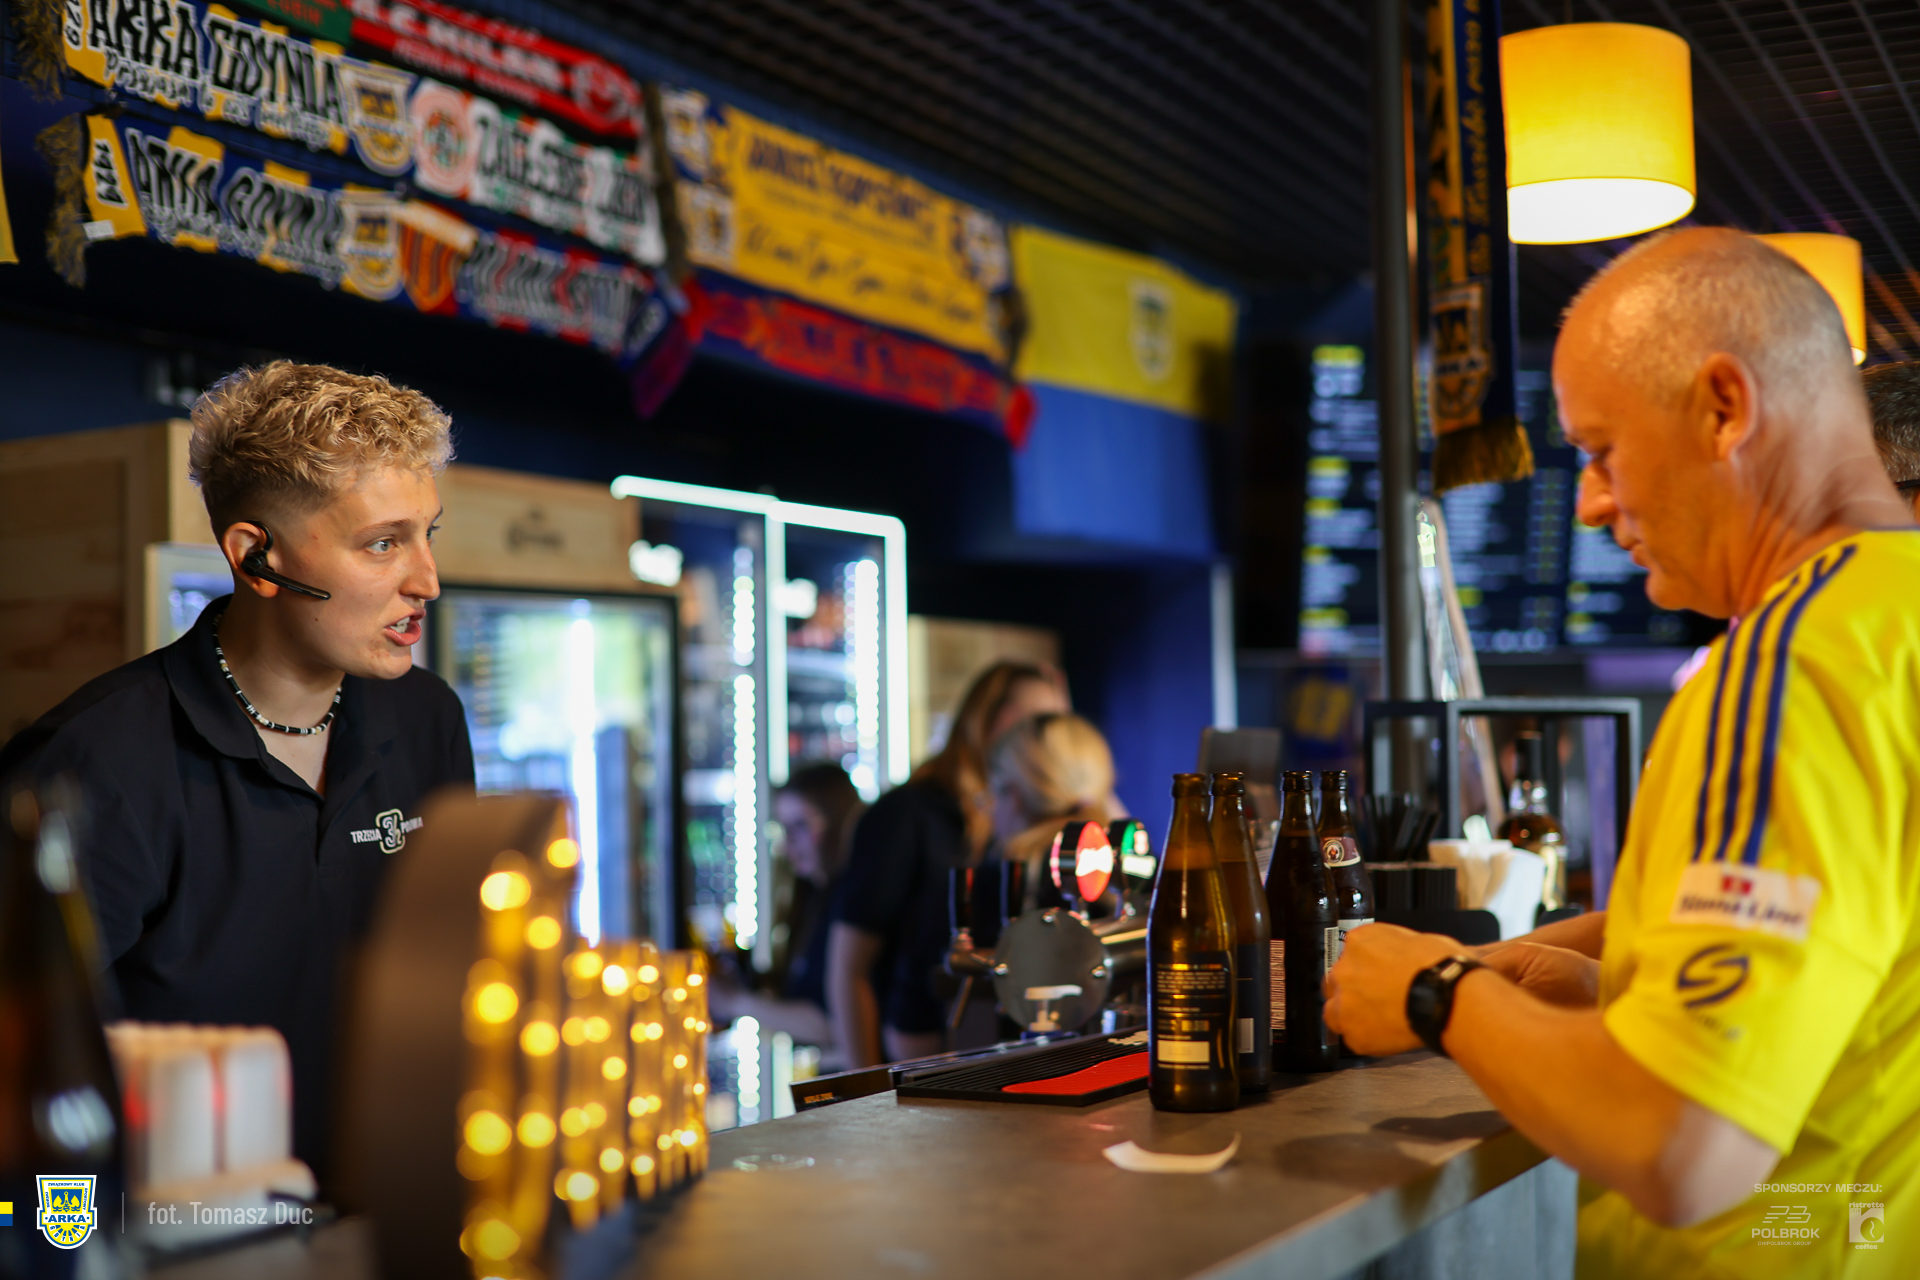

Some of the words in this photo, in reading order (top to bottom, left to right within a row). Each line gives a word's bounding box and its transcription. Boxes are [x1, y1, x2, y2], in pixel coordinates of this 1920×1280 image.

[89, 0, 199, 80] ARKA
[206, 16, 343, 127] GDYNIA
[128, 128, 221, 222] ARKA
